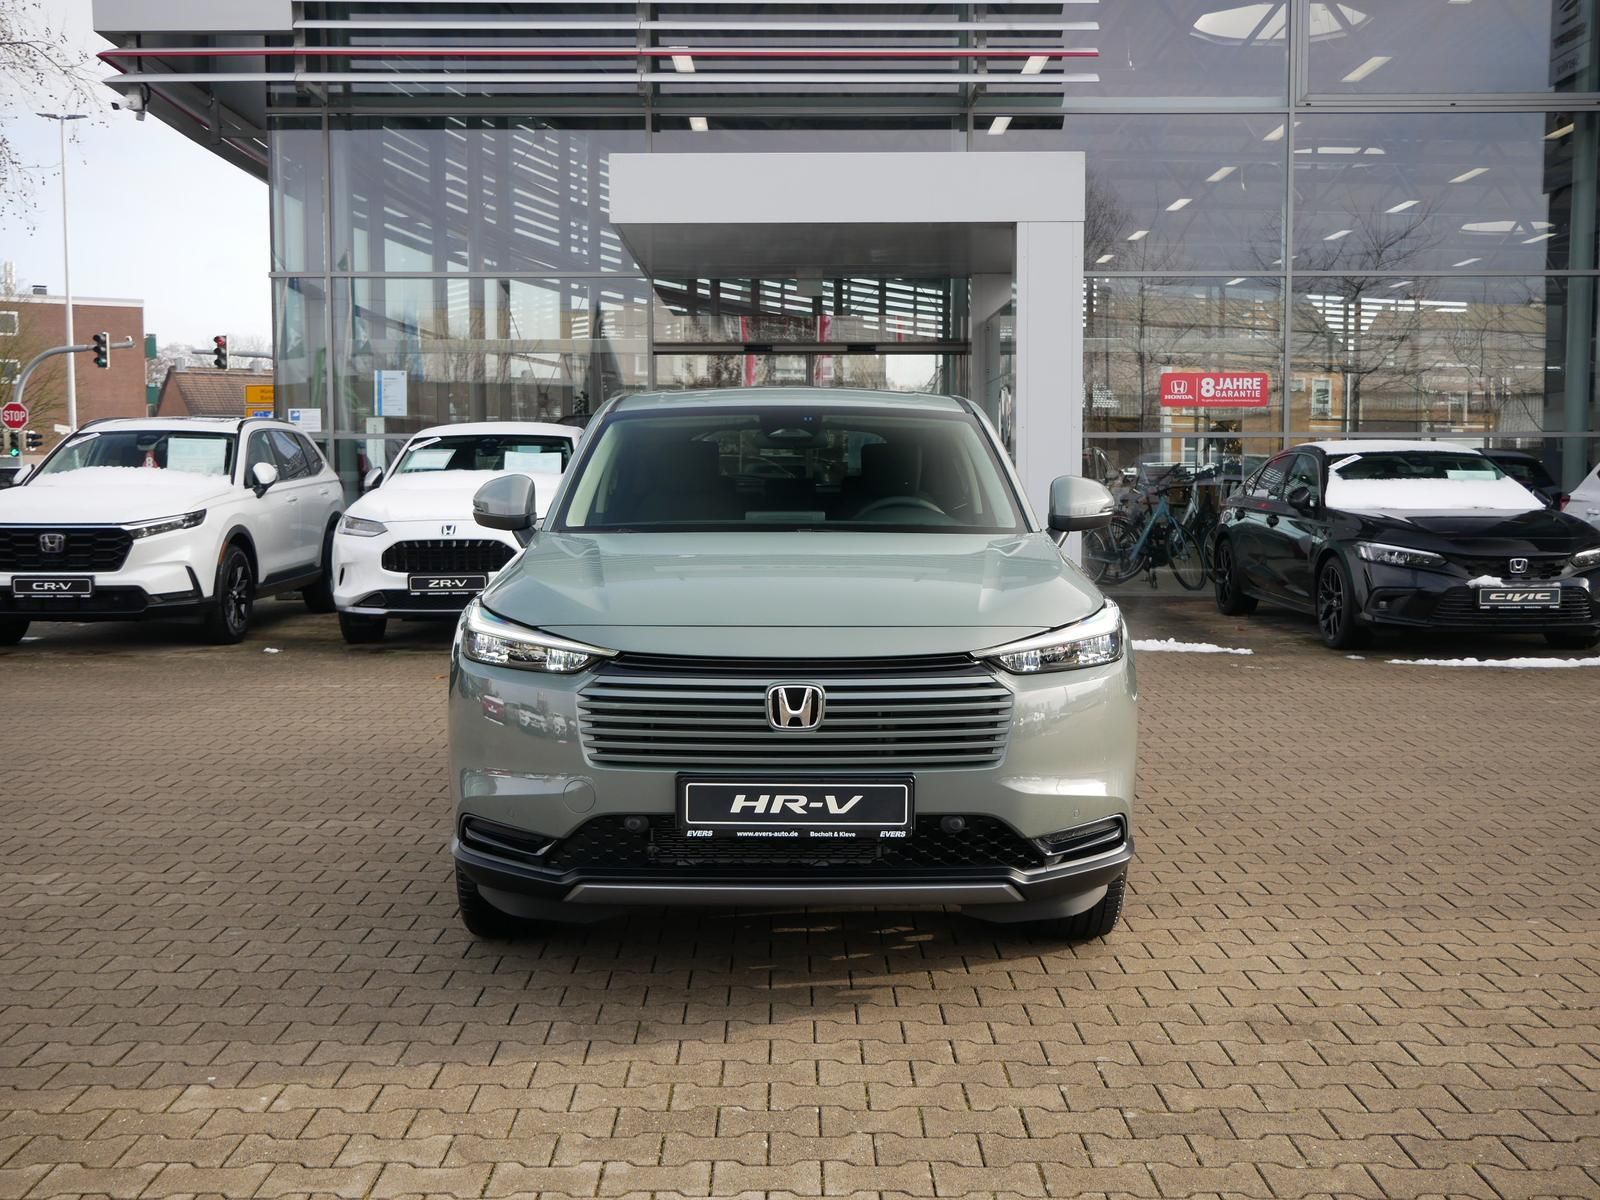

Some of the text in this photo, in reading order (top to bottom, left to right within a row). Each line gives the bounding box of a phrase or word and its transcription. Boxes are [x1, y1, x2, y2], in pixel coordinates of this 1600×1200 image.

[1201, 377, 1215, 398] 8
[1215, 390, 1261, 398] GARANTIE
[3, 410, 26, 422] STOP
[32, 582, 72, 591] CR-V
[428, 579, 468, 588] ZR-V
[1489, 593, 1551, 602] CIVIC
[729, 794, 864, 815] HR-V
[736, 830, 799, 838] www.evers-auto.de
[879, 830, 907, 838] EVERS
